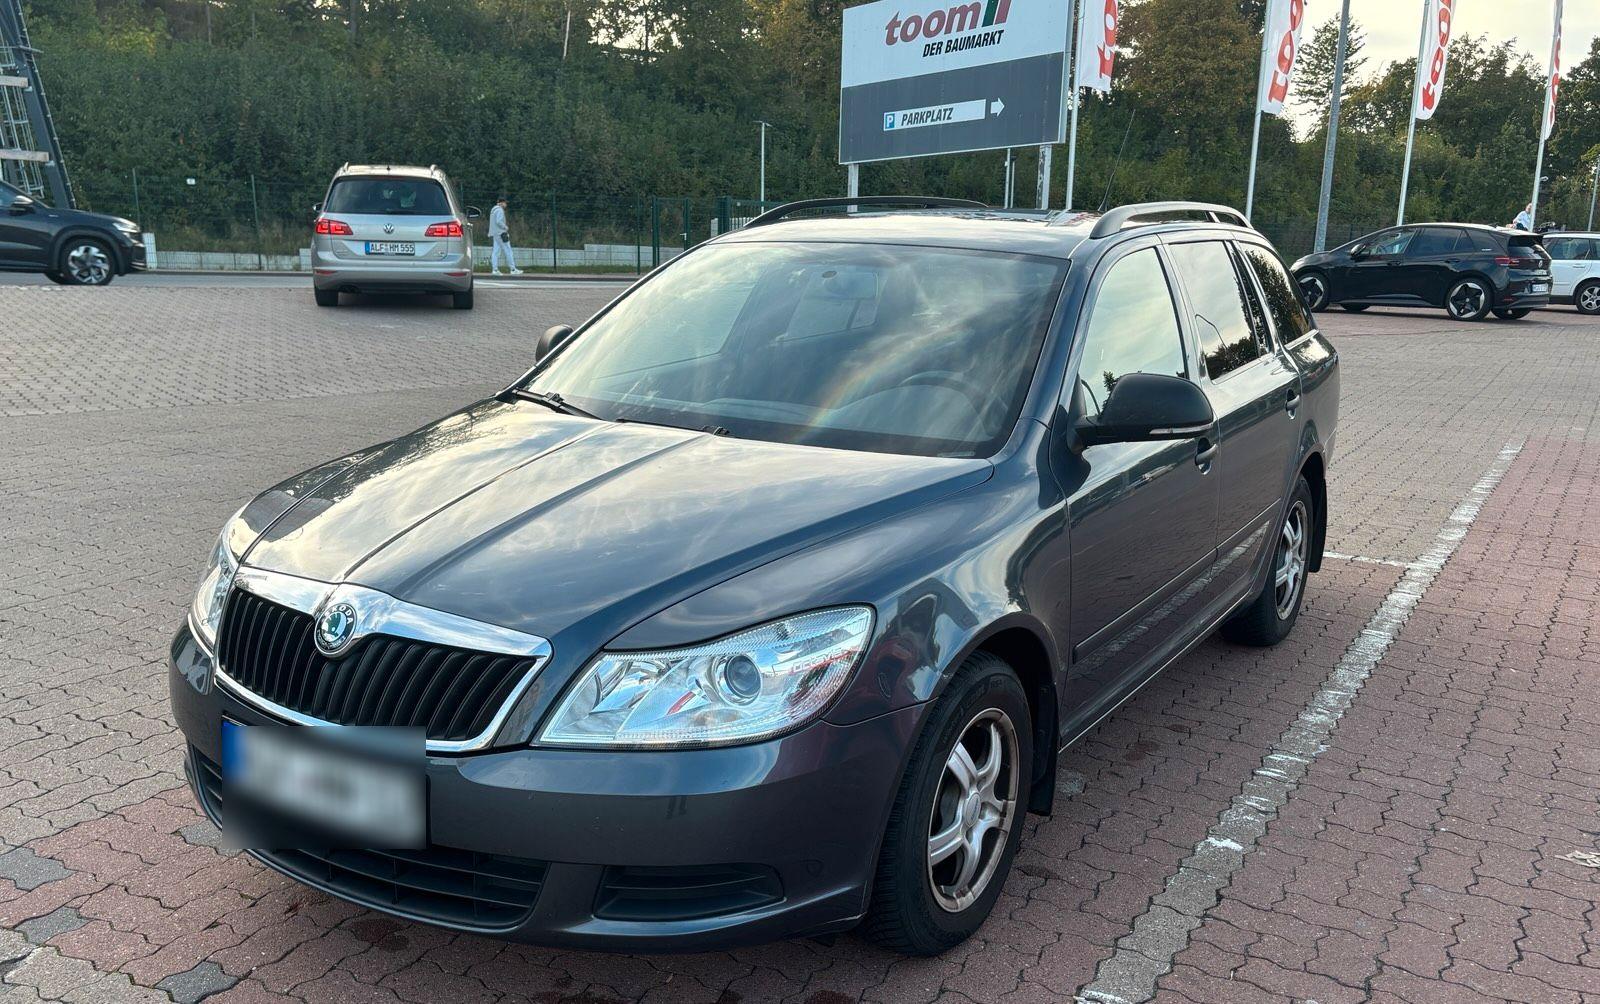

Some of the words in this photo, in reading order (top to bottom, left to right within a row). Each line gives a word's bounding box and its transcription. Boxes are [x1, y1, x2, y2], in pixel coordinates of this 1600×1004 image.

[885, 1, 982, 46] toom
[922, 40, 942, 58] DER
[944, 29, 1005, 54] BAUMARKT
[886, 115, 894, 128] P
[901, 107, 954, 126] PARKPLATZ
